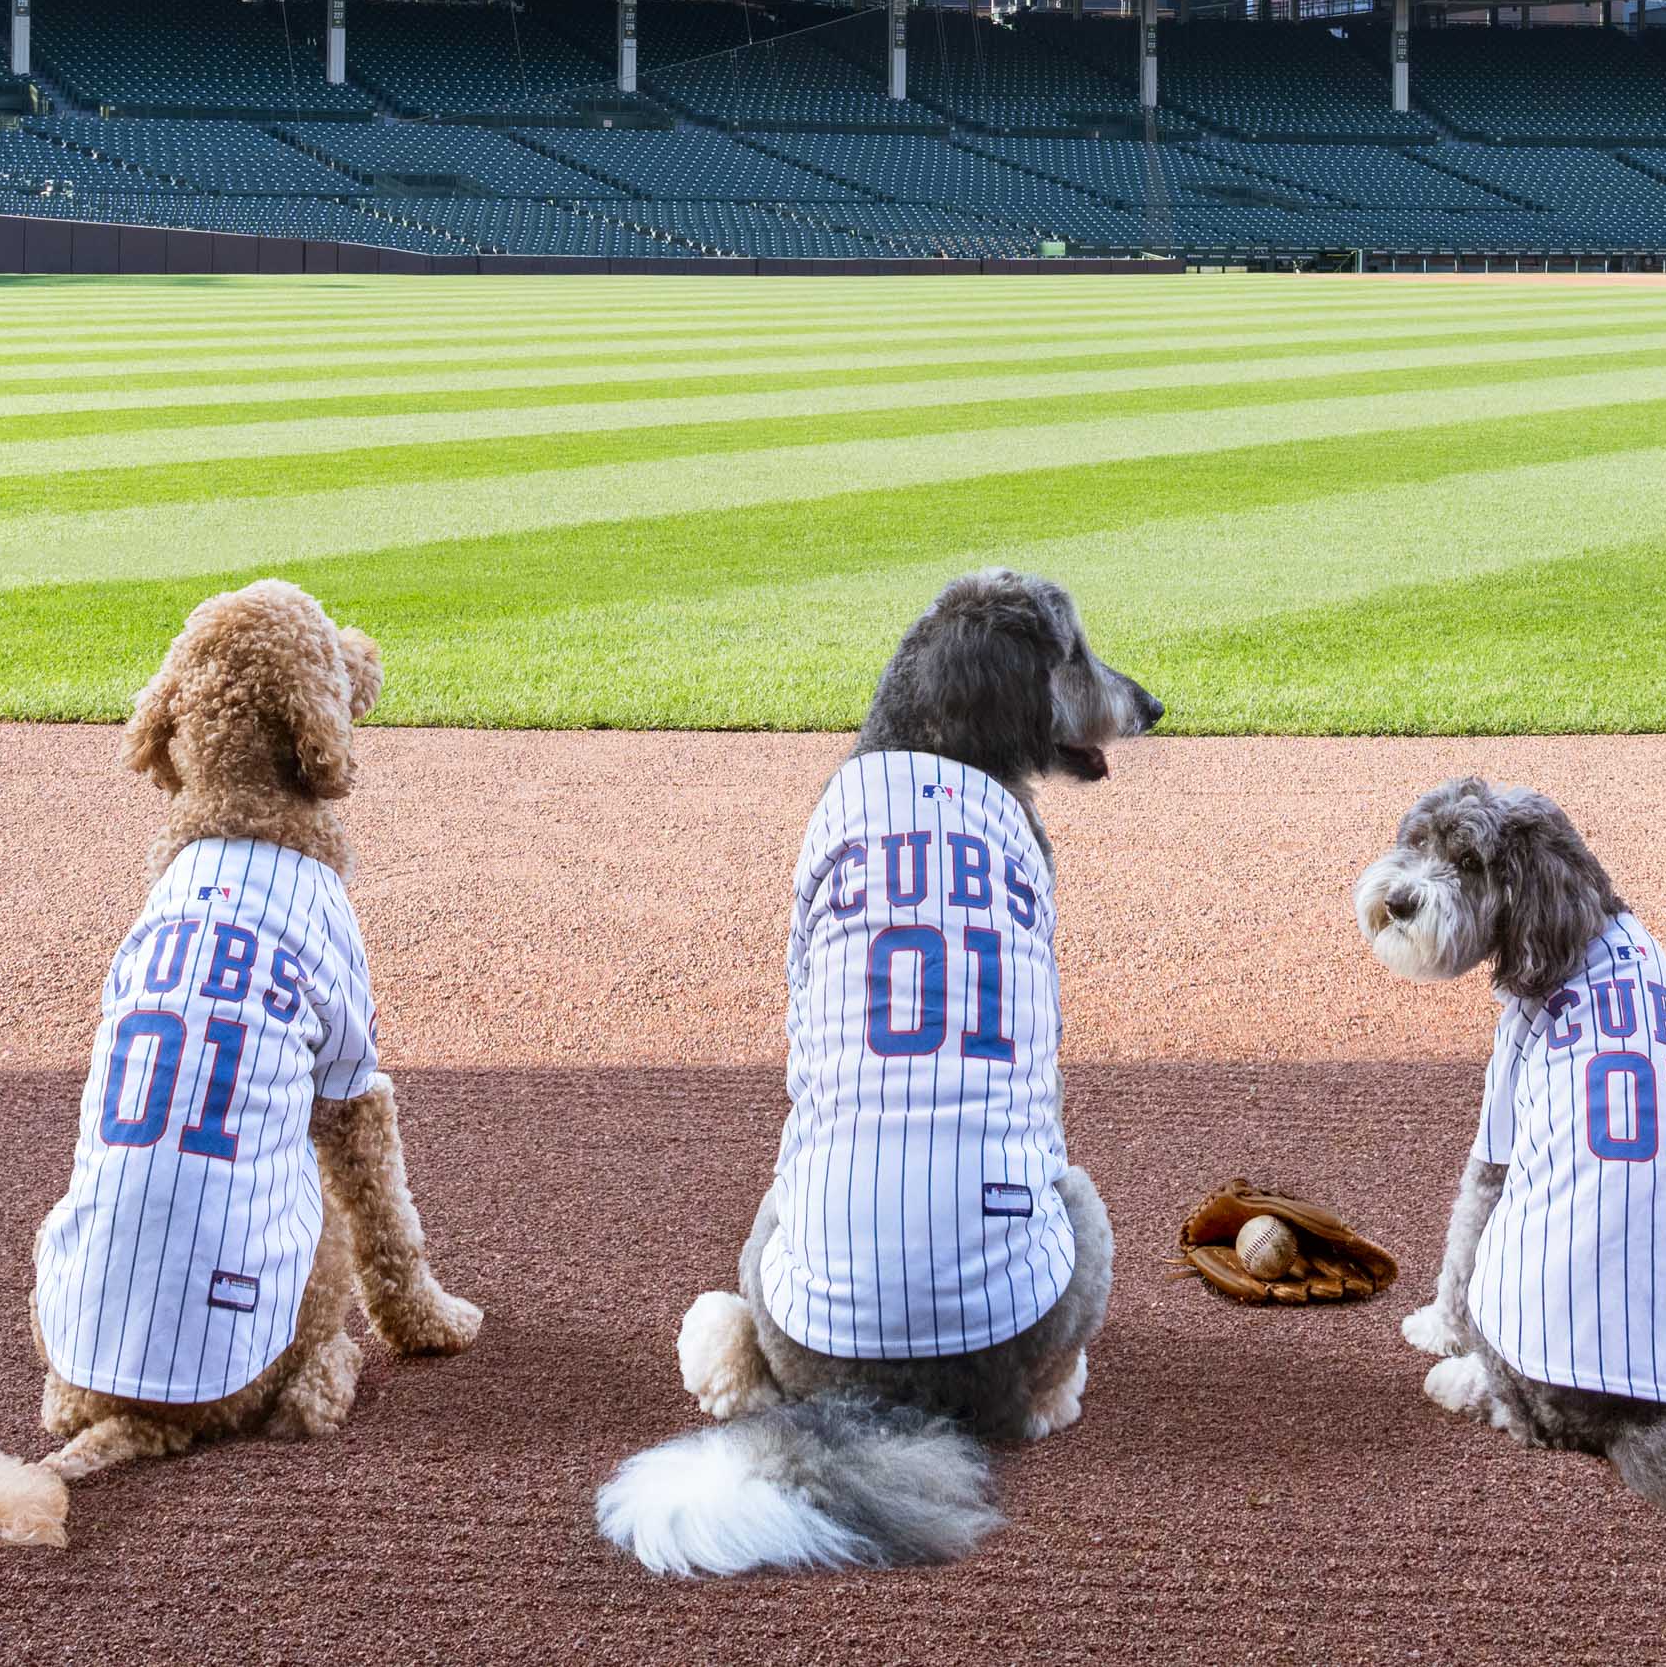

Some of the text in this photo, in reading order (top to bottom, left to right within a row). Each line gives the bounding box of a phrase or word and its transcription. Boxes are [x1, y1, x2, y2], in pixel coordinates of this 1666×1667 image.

[829, 830, 1036, 931] CUBS
[866, 924, 1017, 1064] 01
[100, 1009, 248, 1162] 01
